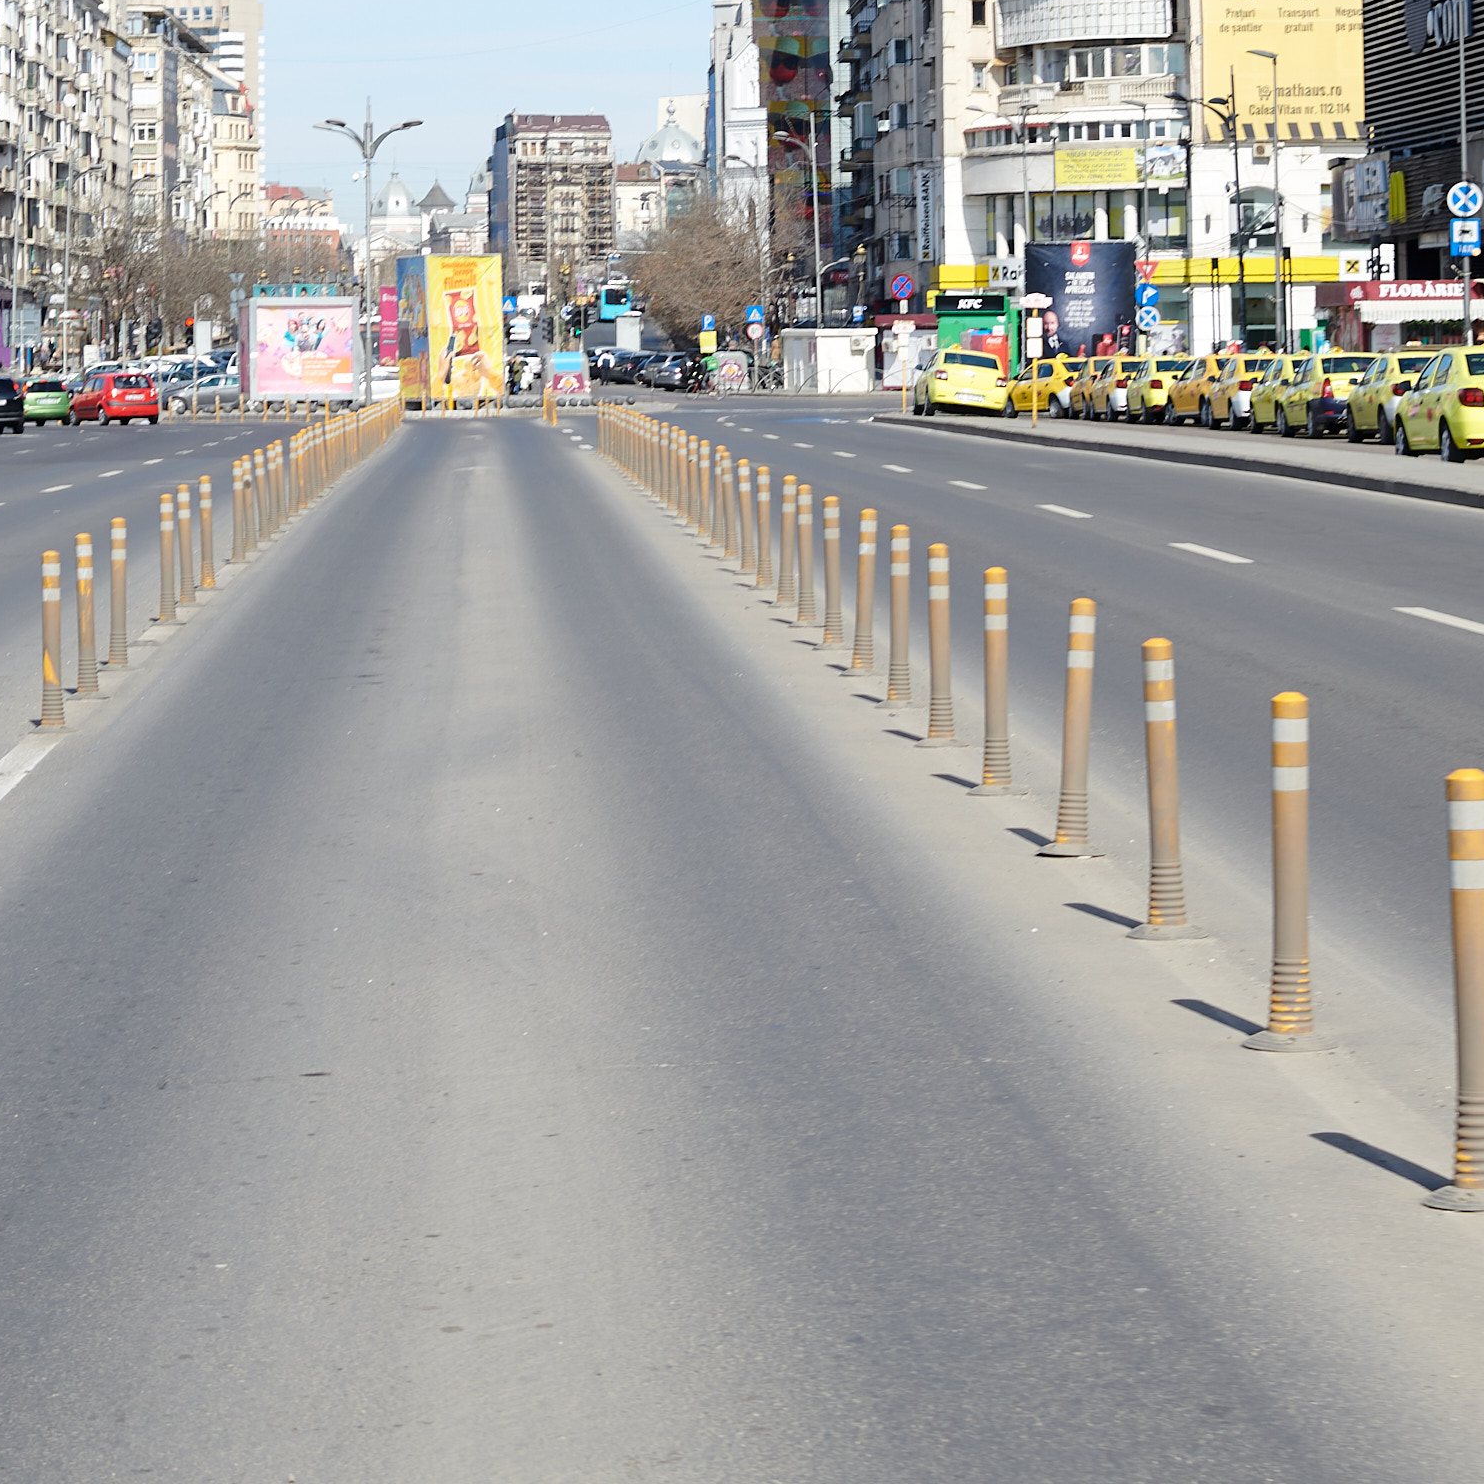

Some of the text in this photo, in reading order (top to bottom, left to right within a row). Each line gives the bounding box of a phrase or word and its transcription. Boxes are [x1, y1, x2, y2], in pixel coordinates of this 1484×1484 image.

[1275, 83, 1342, 97] mathaus.ro
[1277, 104, 1302, 115] Vitan
[921, 172, 930, 201] BANK
[1379, 280, 1465, 298] FLORĂRIE
[957, 299, 982, 309] KFC
